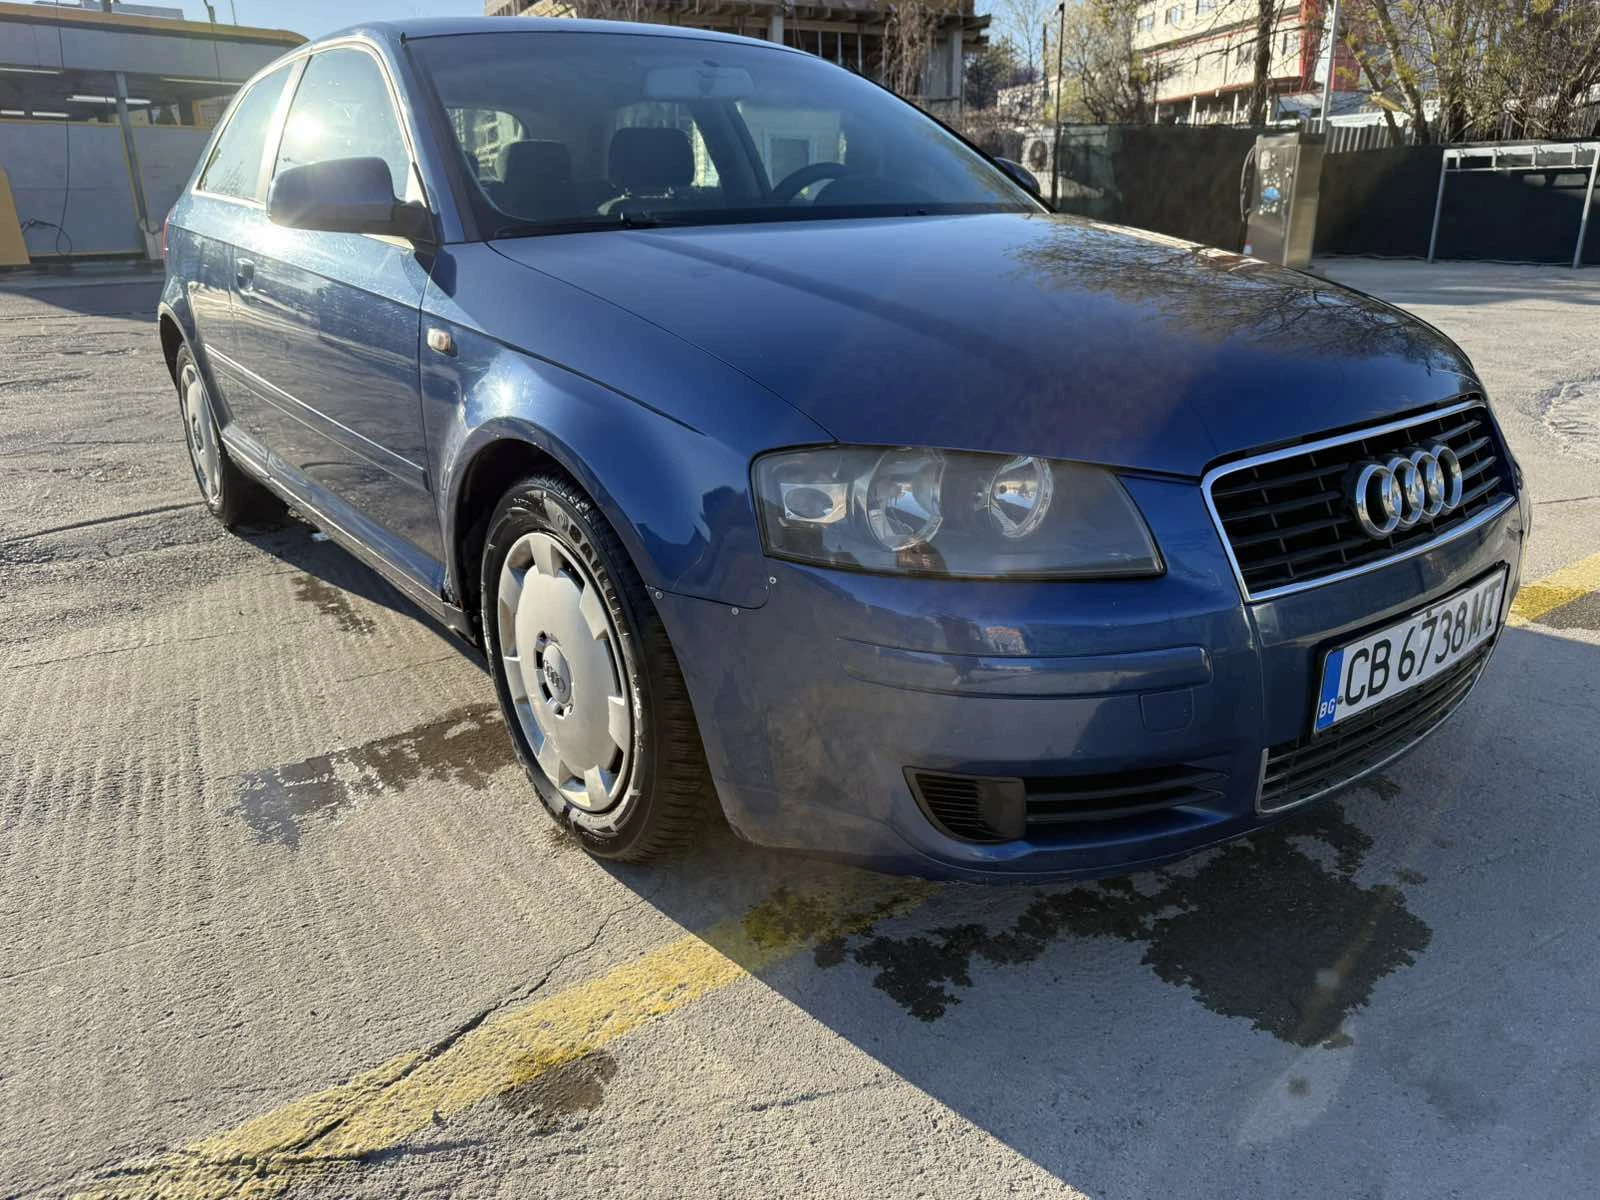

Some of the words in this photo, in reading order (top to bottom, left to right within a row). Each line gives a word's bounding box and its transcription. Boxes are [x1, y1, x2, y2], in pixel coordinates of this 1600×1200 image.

[1345, 638, 1392, 706] CB
[1397, 601, 1468, 682] 6738
[1319, 698, 1336, 718] BG
